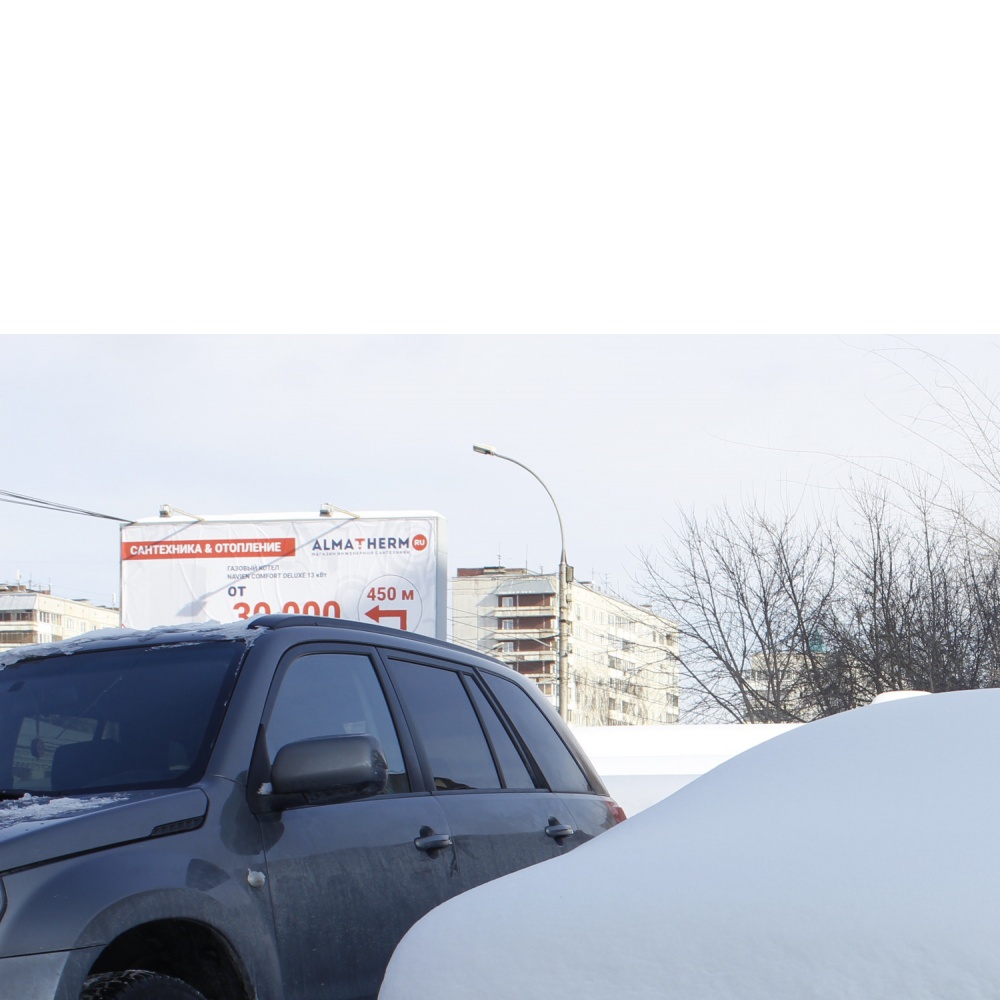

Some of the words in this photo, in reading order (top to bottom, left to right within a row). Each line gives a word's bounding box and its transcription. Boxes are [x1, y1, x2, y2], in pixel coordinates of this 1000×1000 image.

[130, 543, 203, 556] САНТЕХНИКА
[205, 543, 213, 554] &
[215, 541, 282, 554] ОТОПЛЕНИЕ
[312, 537, 410, 551] ALMATHERM
[367, 587, 396, 601] 450
